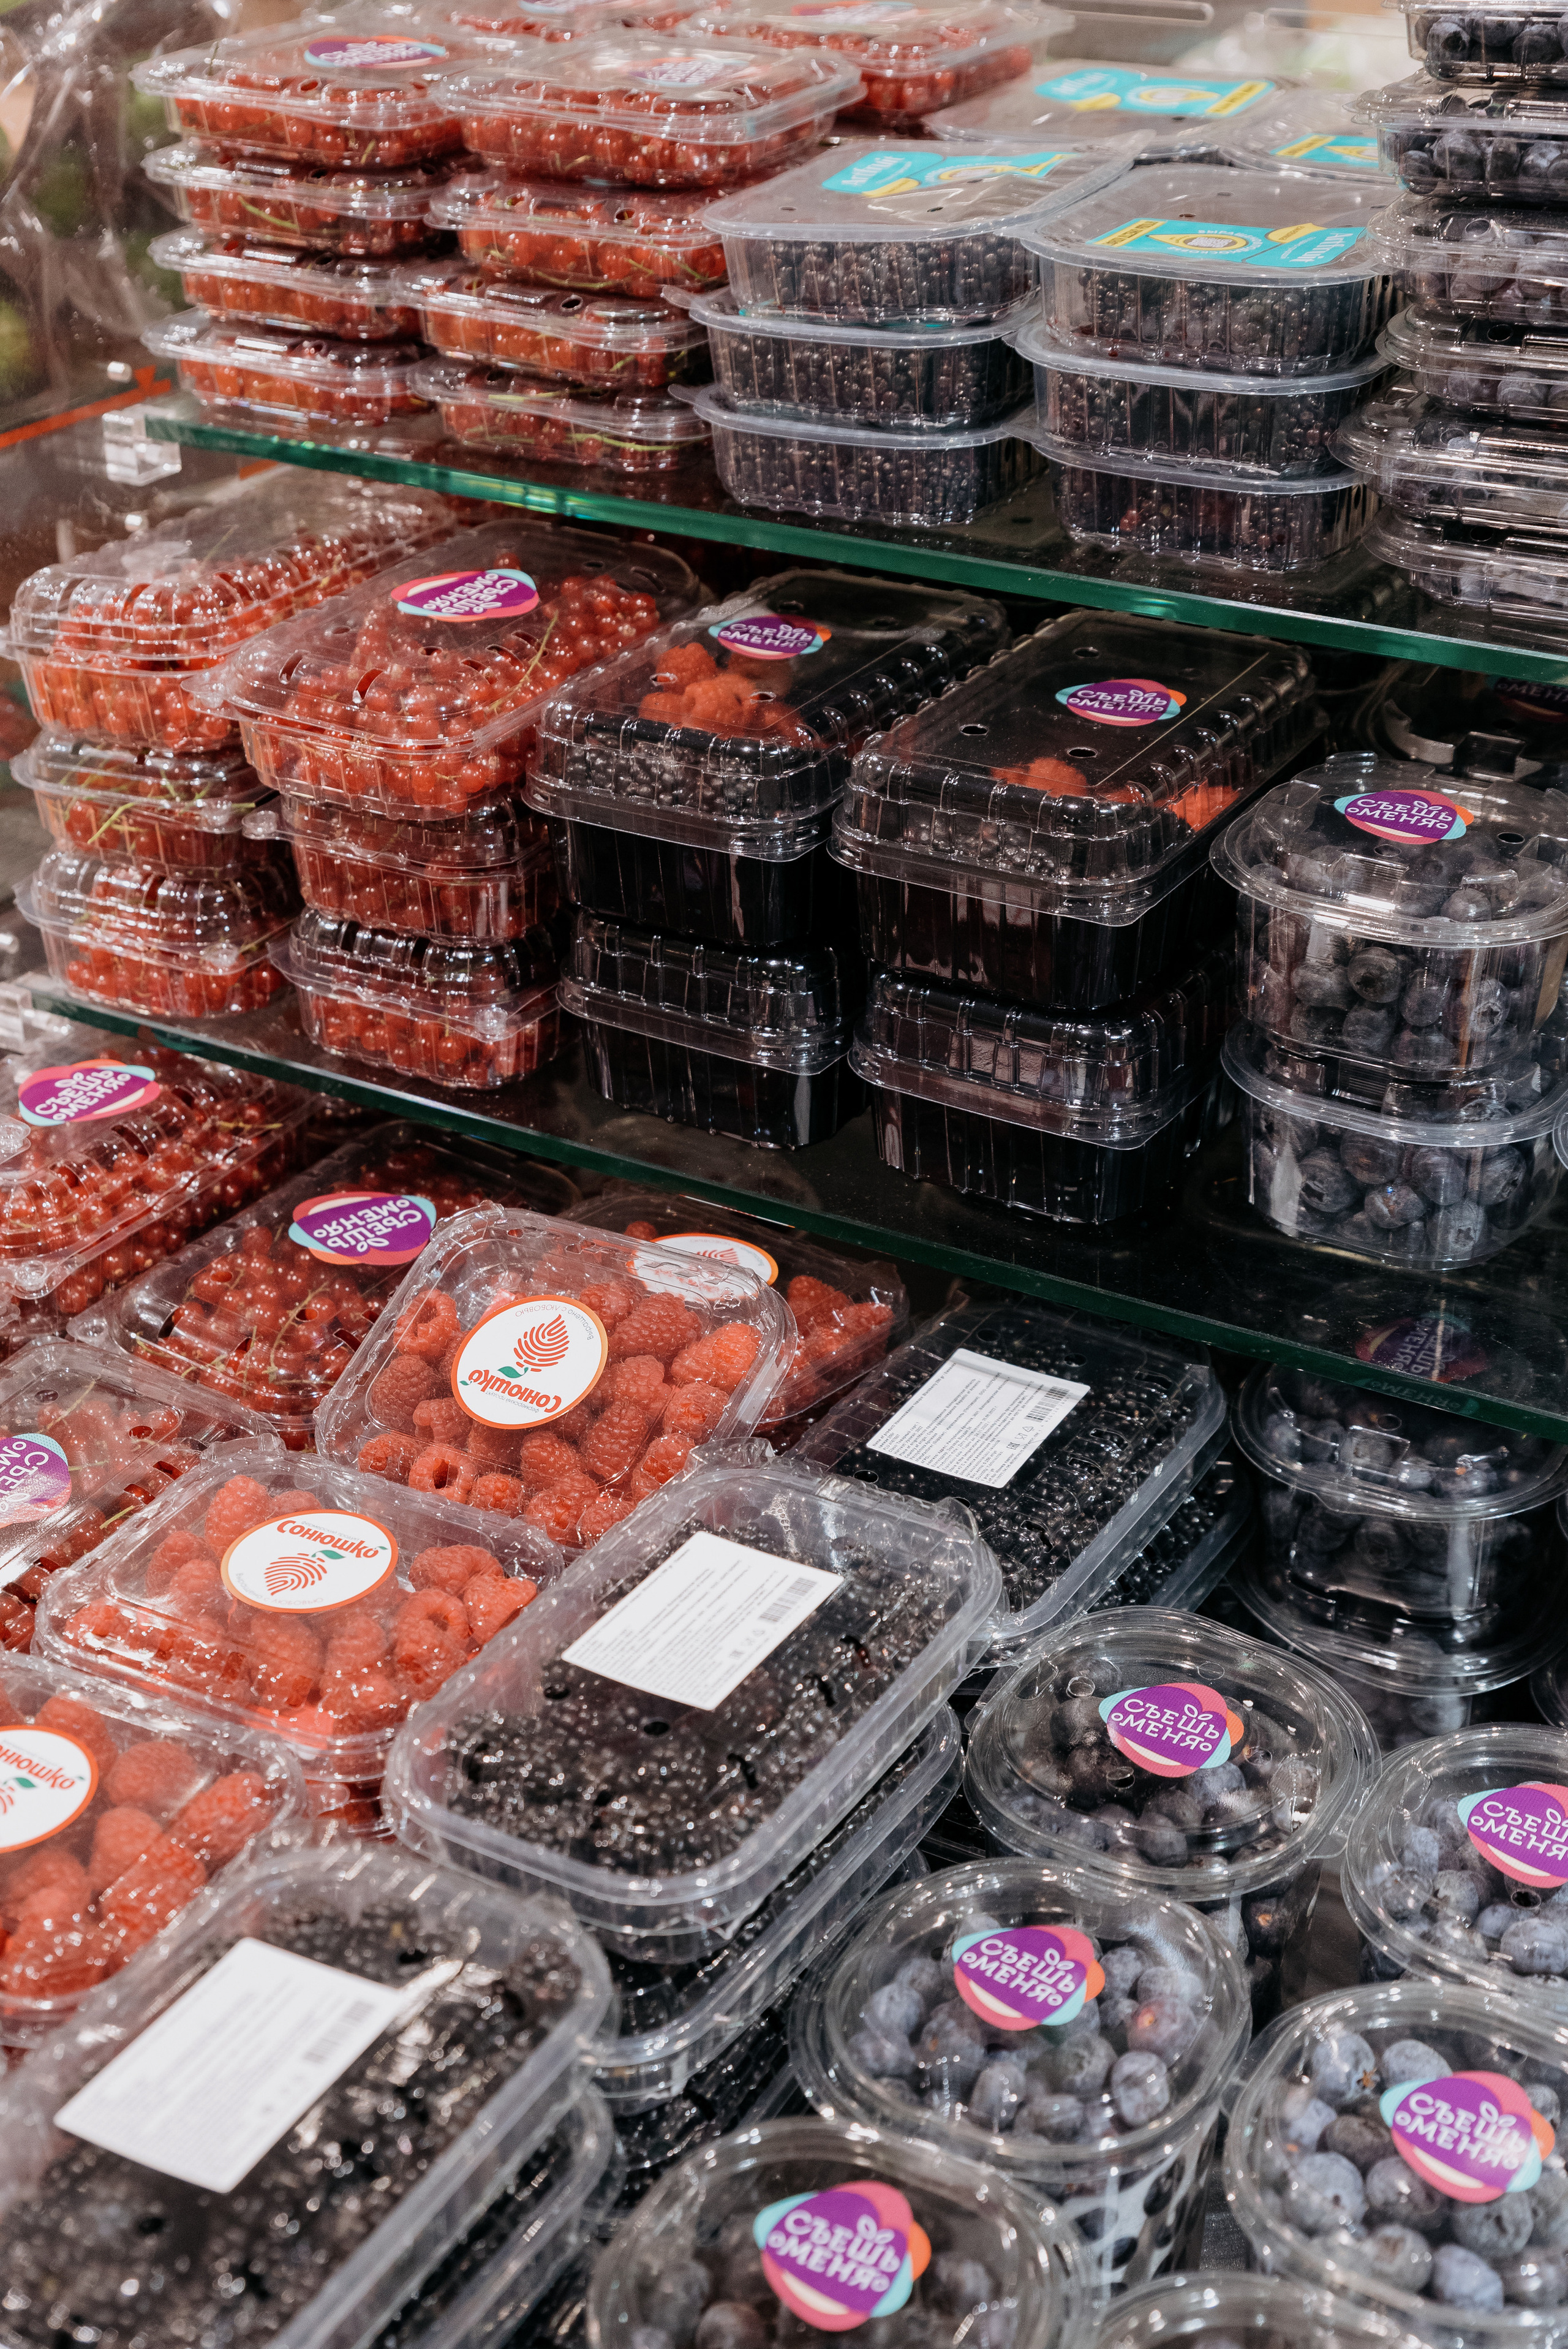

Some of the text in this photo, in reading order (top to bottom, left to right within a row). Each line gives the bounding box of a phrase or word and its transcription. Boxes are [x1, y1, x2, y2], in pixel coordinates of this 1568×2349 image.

[1289, 232, 1354, 263] Artfruit
[432, 575, 494, 608] МЕНЯ
[441, 579, 518, 613] СЪЕШЬ
[1077, 690, 1167, 706] СЪЕШЬ
[1077, 698, 1156, 713] МЕНЯ
[1506, 683, 1568, 702] МЕН
[1356, 808, 1441, 829] МЕНЯ
[1357, 799, 1453, 822] СЪЕШЬ
[35, 1070, 115, 1115] СЪЕШЬ
[59, 1076, 126, 1118] МЕНЯ
[322, 1199, 401, 1238] МЕНЯ
[326, 1209, 423, 1249] СЪЕШЬ
[514, 1304, 560, 1317] ЛЮБОВЬЮ
[567, 1309, 594, 1341] Выращено
[468, 1369, 562, 1413] Сонюшко
[505, 1398, 540, 1413] фермерский
[0, 1451, 49, 1494] СЪЕ
[276, 1519, 379, 1559] Сонюшко
[1118, 1714, 1205, 1750] МЕНЯ
[1123, 1698, 1220, 1739] СЪЕШЬ
[0, 1745, 75, 1789] нюшко
[1480, 1818, 1568, 1861] МЕНЯ
[1483, 1801, 1568, 1843] СЪЕШ
[968, 1954, 1058, 2003] МЕНЯ
[980, 1938, 1076, 1993] СЪЕШЬ
[1406, 2115, 1506, 2168] МЕНЯ
[1409, 2092, 1526, 2153] СЪЕШЬ
[784, 2209, 901, 2273] СЪЕШЬ
[777, 2234, 881, 2291] МЕНЯ
